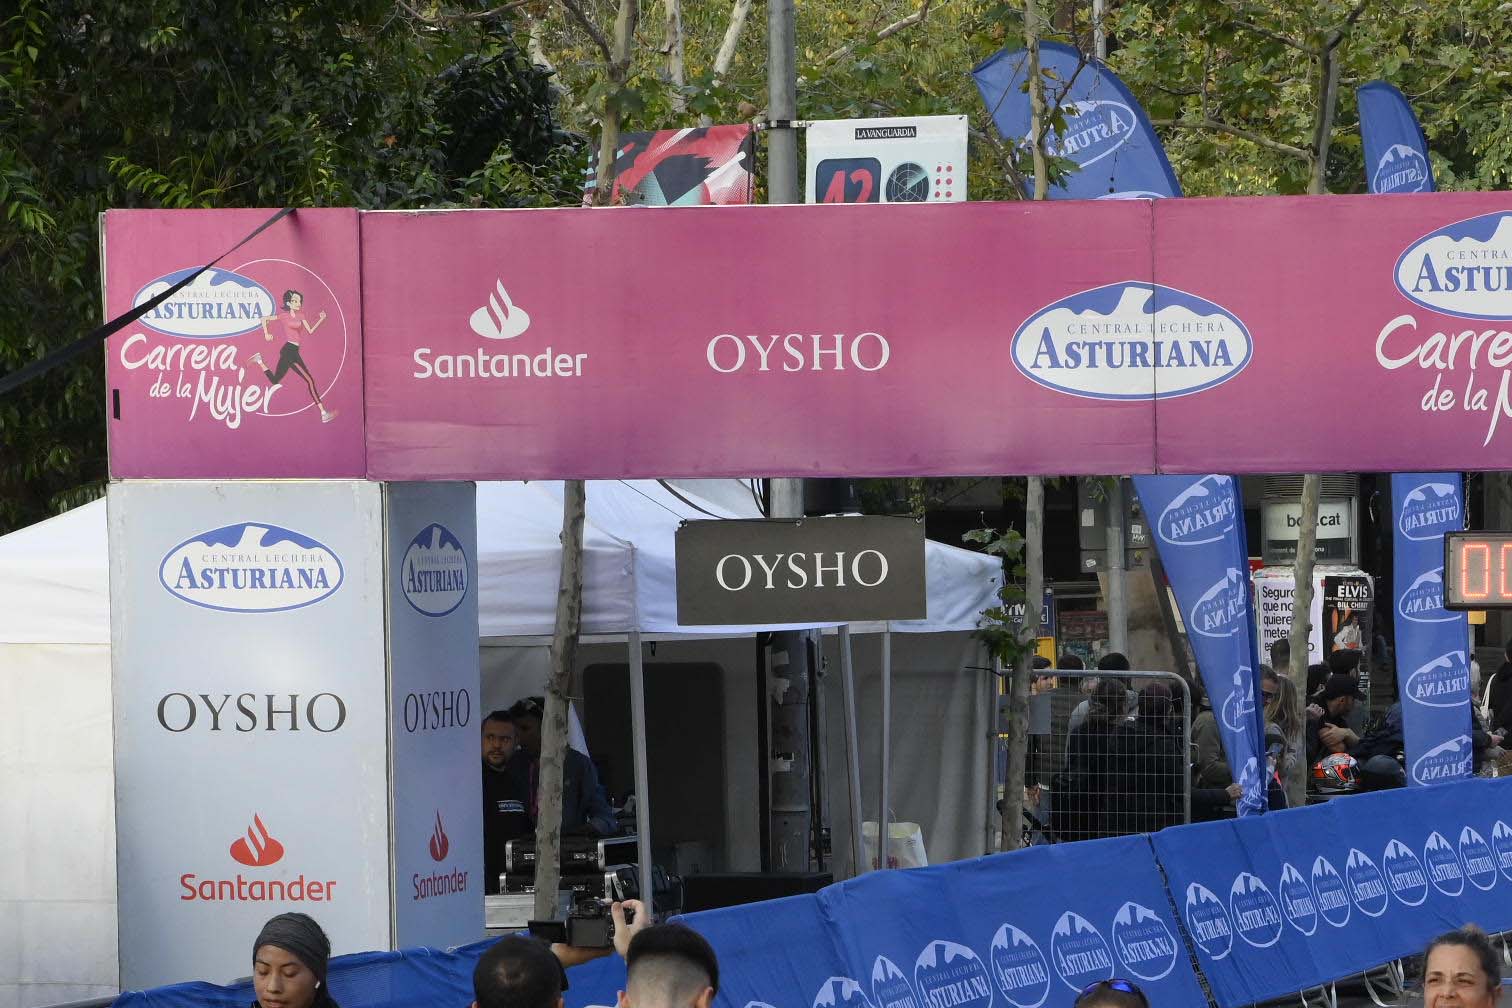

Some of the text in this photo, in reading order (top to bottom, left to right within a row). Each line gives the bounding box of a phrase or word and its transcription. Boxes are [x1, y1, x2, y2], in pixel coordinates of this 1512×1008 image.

[1067, 321, 1226, 335] CENTRAL LECHERA
[120, 333, 238, 370] Carrera
[414, 347, 587, 377] Santander
[706, 333, 890, 373] OYSHO
[1029, 326, 1234, 369] ASTURIANA
[150, 367, 283, 429] de la Mujer
[1421, 373, 1456, 411] de
[1463, 372, 1489, 411] la
[174, 556, 331, 590] ASTURIANA
[407, 563, 464, 593] ASTURIANA
[716, 550, 889, 591] OYSHO
[1263, 602, 1279, 612] que
[1337, 586, 1368, 598] ELVIS
[1264, 614, 1295, 625] quiere
[157, 692, 347, 733] OYSHO
[404, 689, 471, 733] OYSHO
[180, 874, 337, 901] Santander
[412, 870, 468, 900] Santander
[998, 960, 1048, 992] ASTURIANA
[1059, 945, 1111, 977] ASTURIANA
